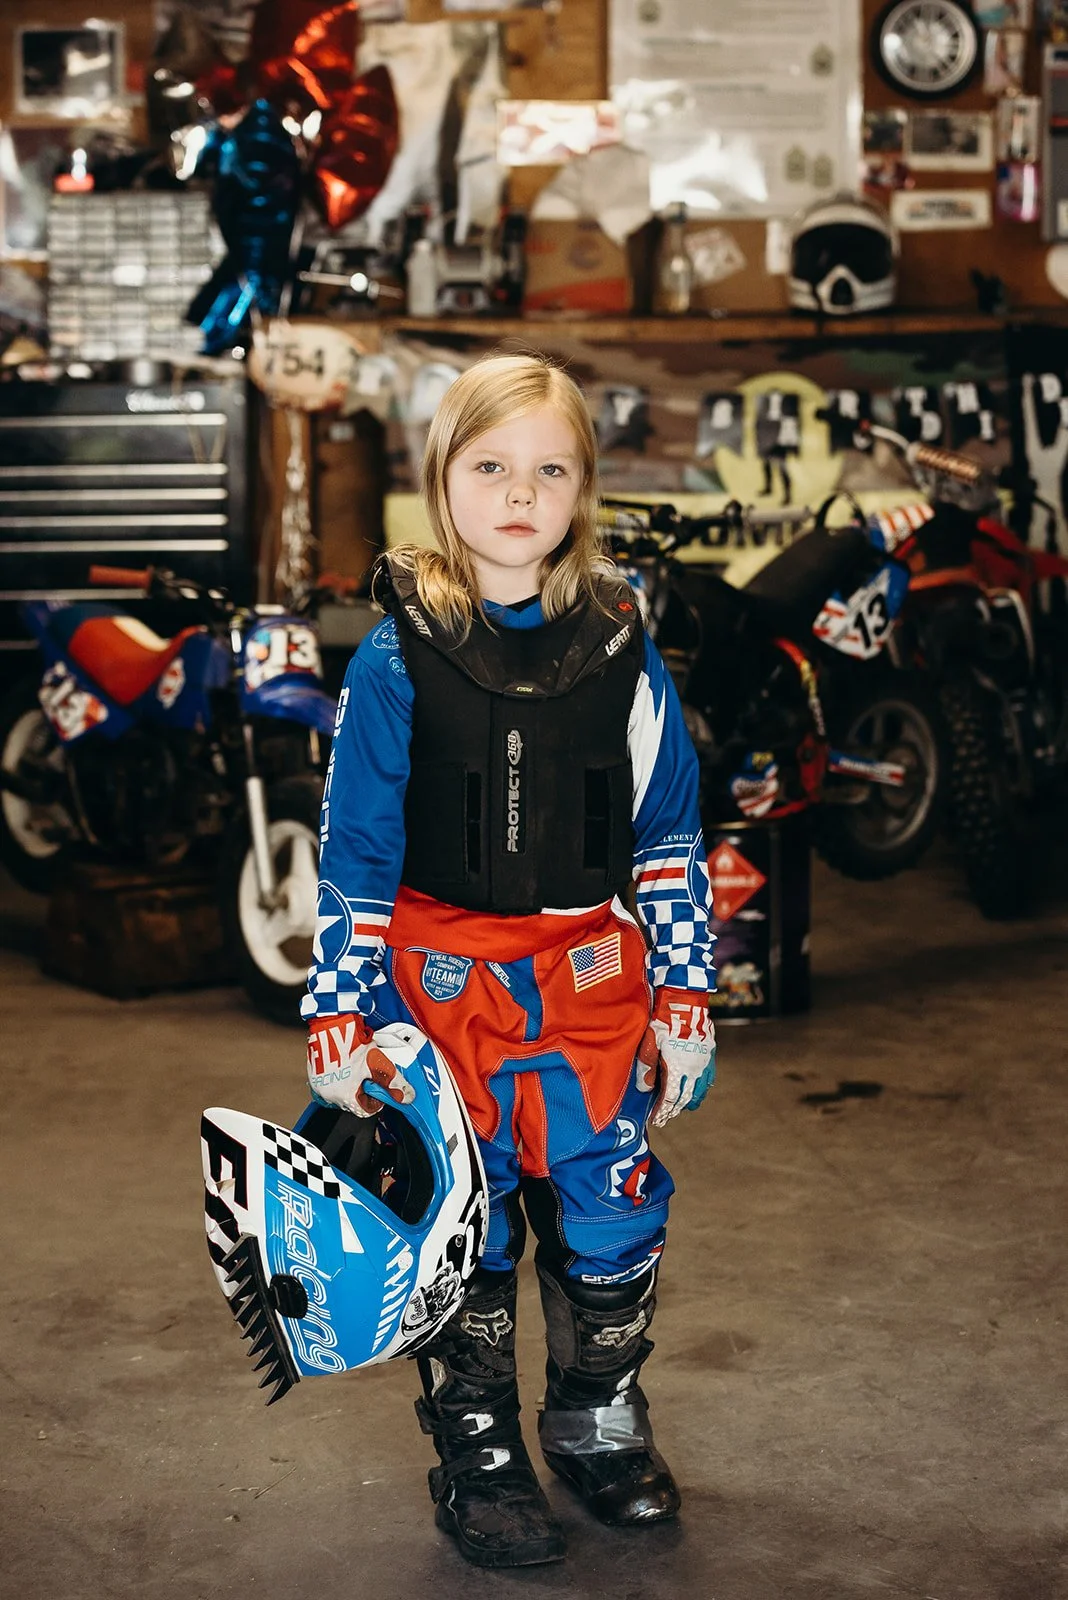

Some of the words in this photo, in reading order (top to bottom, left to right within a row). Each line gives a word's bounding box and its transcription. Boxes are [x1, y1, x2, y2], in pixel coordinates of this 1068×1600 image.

[404, 605, 433, 637] LEATT
[853, 593, 889, 649] 13
[266, 626, 319, 670] 13
[604, 624, 630, 656] LEATT
[507, 732, 518, 761] 360
[507, 766, 519, 852] PROTECT
[659, 833, 694, 843] LEMENT
[431, 967, 457, 984] TEAM
[307, 1021, 356, 1075] FLY
[668, 1039, 708, 1055] RACING
[312, 1066, 352, 1087] RACING
[277, 1180, 347, 1374] Racing
